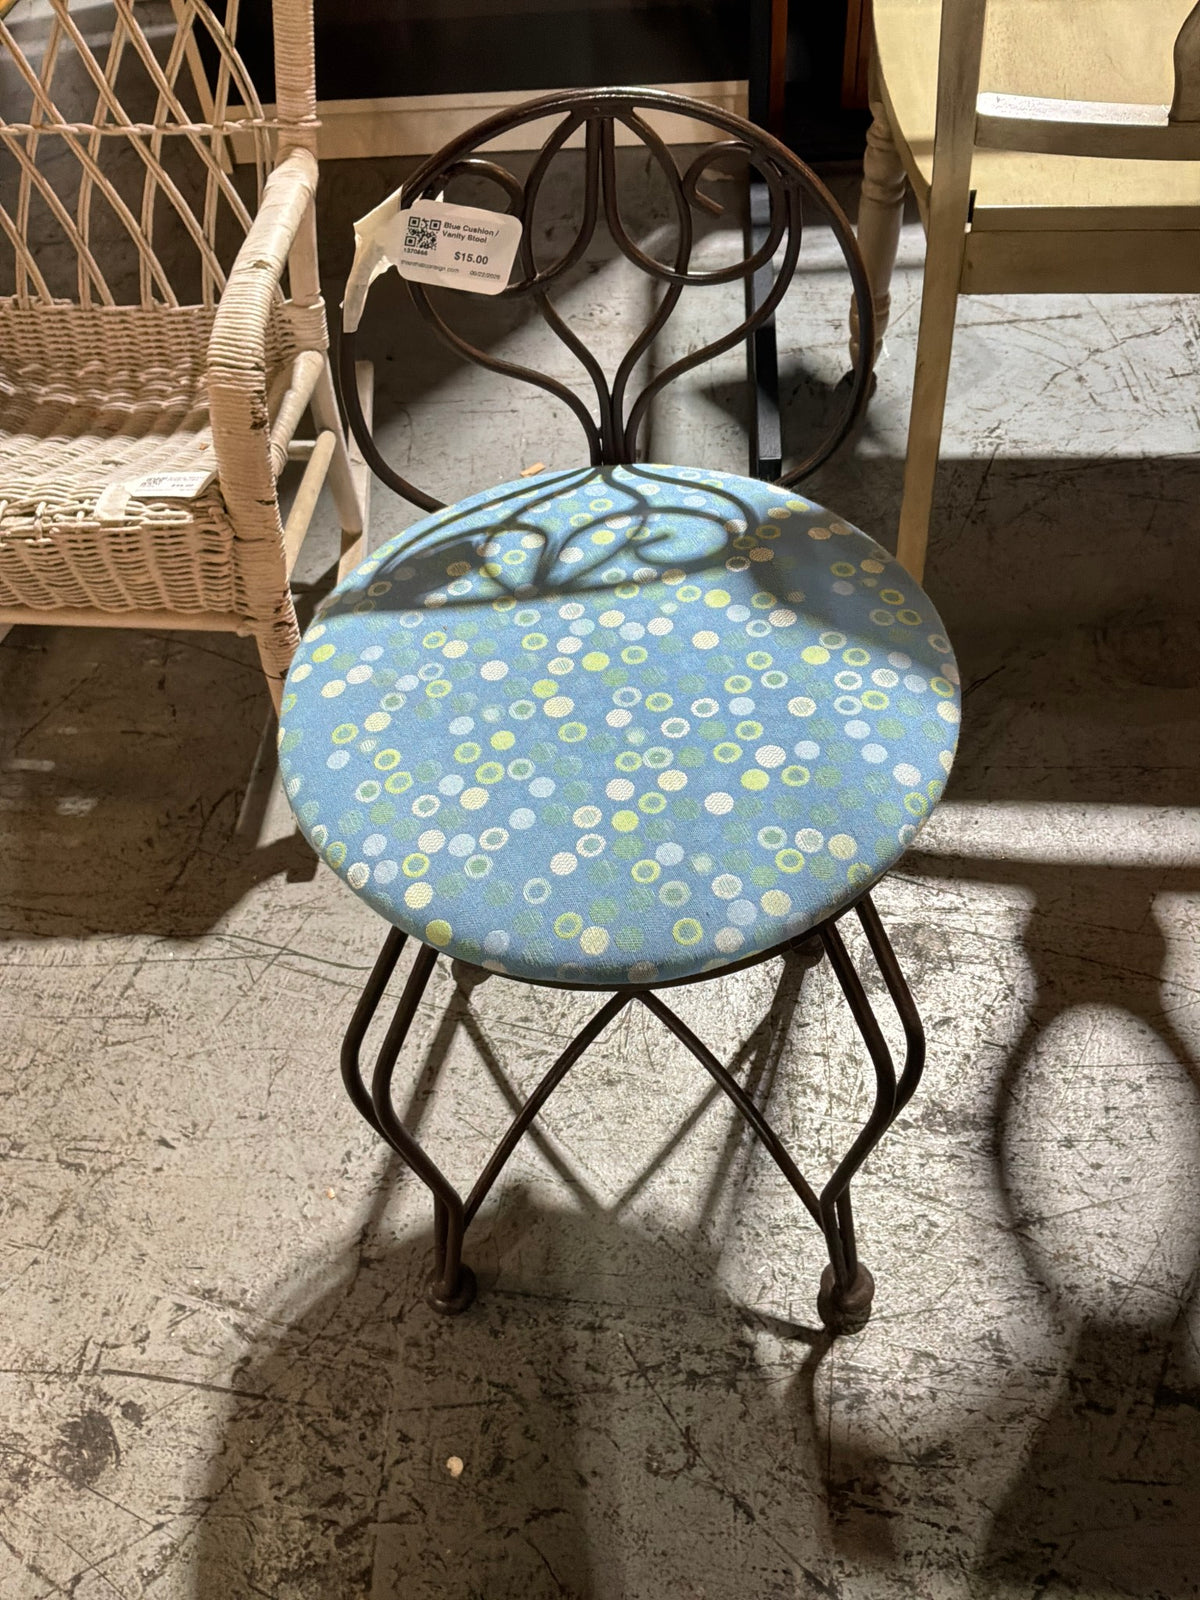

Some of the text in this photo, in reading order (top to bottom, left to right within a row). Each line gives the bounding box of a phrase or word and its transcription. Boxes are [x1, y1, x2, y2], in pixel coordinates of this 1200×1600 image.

[442, 230, 488, 244] Vanity Stool
[443, 222, 500, 238] Blue Cushion /
[454, 251, 489, 265] $15.00
